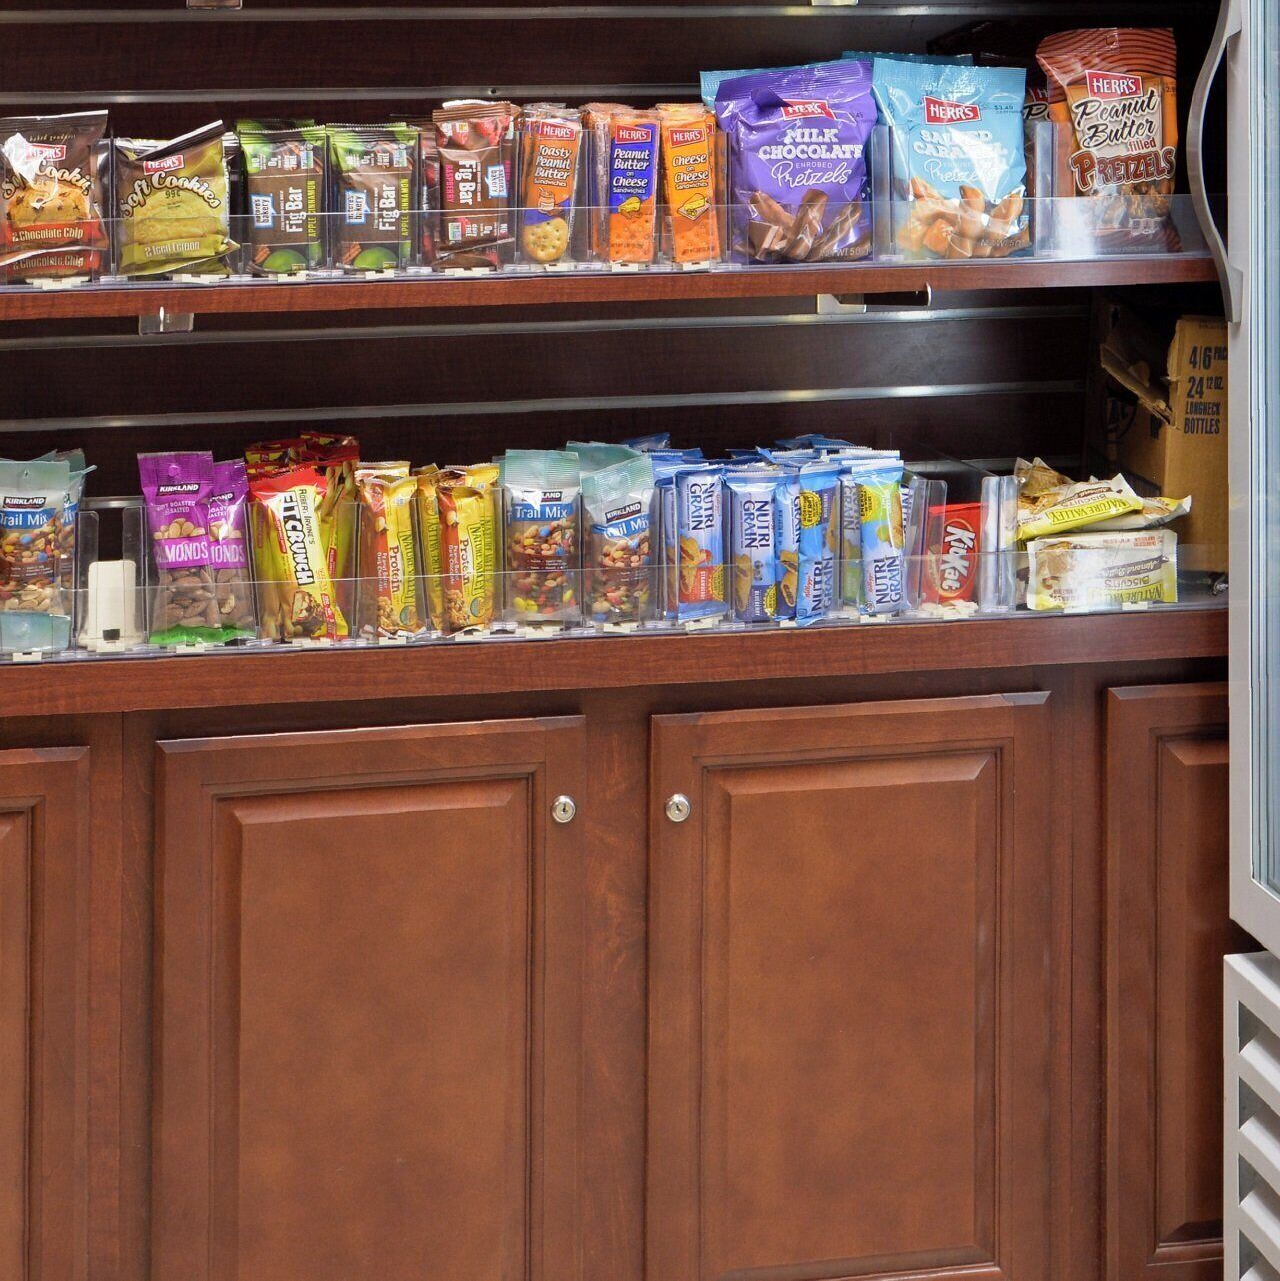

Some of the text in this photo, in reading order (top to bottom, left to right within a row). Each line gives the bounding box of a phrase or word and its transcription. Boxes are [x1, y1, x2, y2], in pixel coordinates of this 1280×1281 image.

[1091, 77, 1137, 95] HERR'S
[1073, 95, 1157, 122] Peanut
[619, 127, 648, 141] HERR'S
[673, 130, 703, 143] HERR'S
[786, 127, 838, 144] MILK
[1079, 120, 1157, 148] Butter
[539, 145, 571, 159] Toasty
[613, 148, 650, 160] Peanut
[758, 143, 864, 160] CHOCOLATE
[1127, 137, 1156, 154] filled
[614, 158, 650, 170] Butter
[673, 153, 707, 166] Cheese
[1072, 147, 1176, 189] PRETZELS
[613, 176, 648, 187] Cheese
[771, 165, 851, 189] Pretzels
[675, 182, 708, 190] Sandwiches
[121, 171, 221, 219] Soft Cookies
[285, 187, 306, 233] Fig Bar
[1186, 376, 1204, 399] 24
[1206, 376, 1214, 390] 12
[1185, 401, 1221, 415] LONGNECK
[1184, 418, 1220, 435] BOTTLES
[159, 484, 199, 494] KIRKLAND
[4, 497, 46, 506] KIRKLAND
[0, 512, 48, 526] Trail Mix
[516, 506, 568, 519] Trail Mix
[743, 500, 758, 548] GRAIN
[755, 500, 770, 547] NUTRI
[156, 540, 209, 563] ALMONDS
[389, 546, 401, 594] Protein
